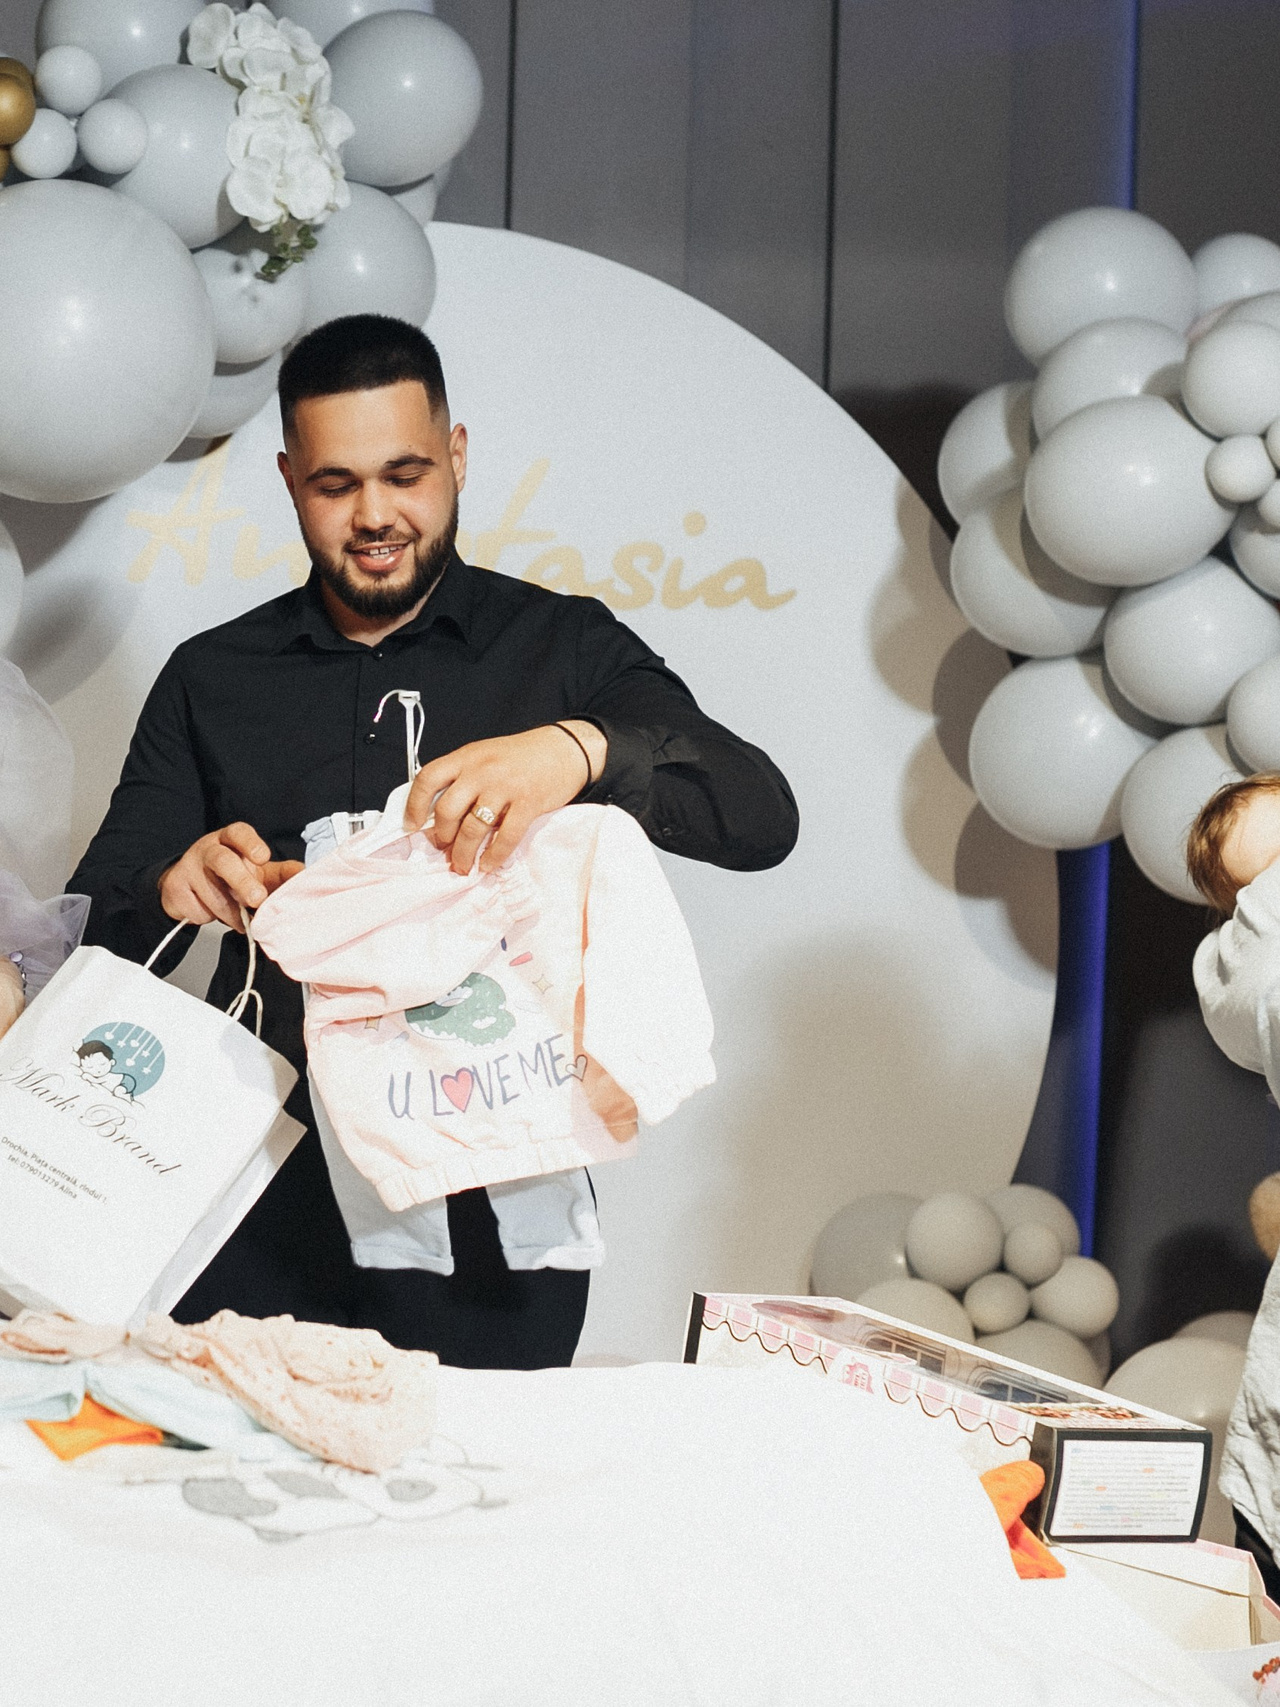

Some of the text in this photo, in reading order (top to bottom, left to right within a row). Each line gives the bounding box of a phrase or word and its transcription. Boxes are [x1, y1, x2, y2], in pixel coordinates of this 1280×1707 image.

[125, 437, 797, 611] Antasia
[388, 1071, 415, 1121] U
[77, 1103, 182, 1176] Brand
[59, 1184, 78, 1200] Alina
